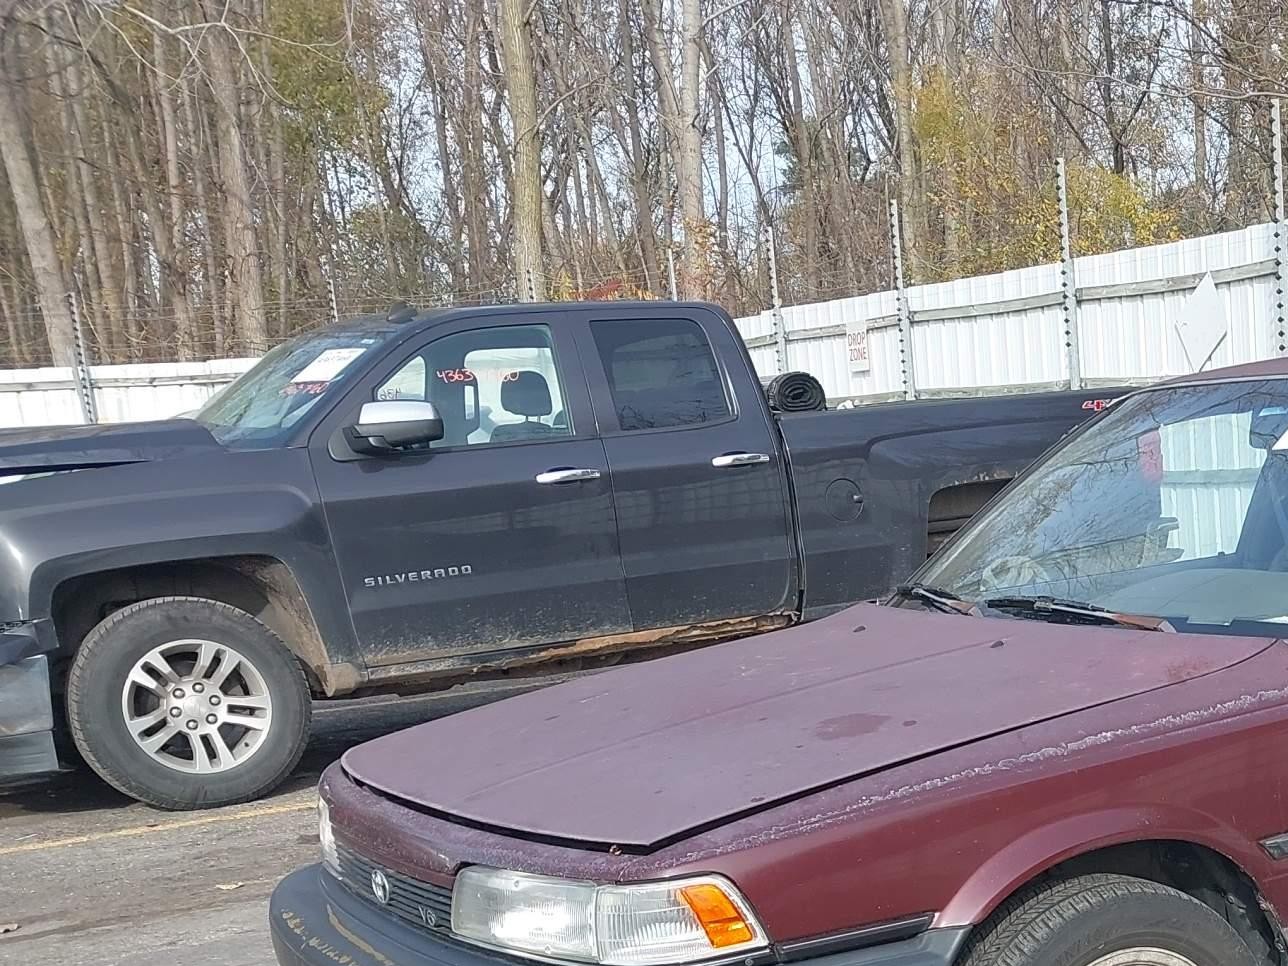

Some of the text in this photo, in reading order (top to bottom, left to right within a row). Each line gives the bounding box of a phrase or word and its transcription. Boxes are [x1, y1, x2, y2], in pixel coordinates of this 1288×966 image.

[848, 331, 865, 346] DROP
[849, 346, 867, 361] ZONE
[364, 565, 472, 587] SILVERADO
[418, 905, 436, 926] V6
